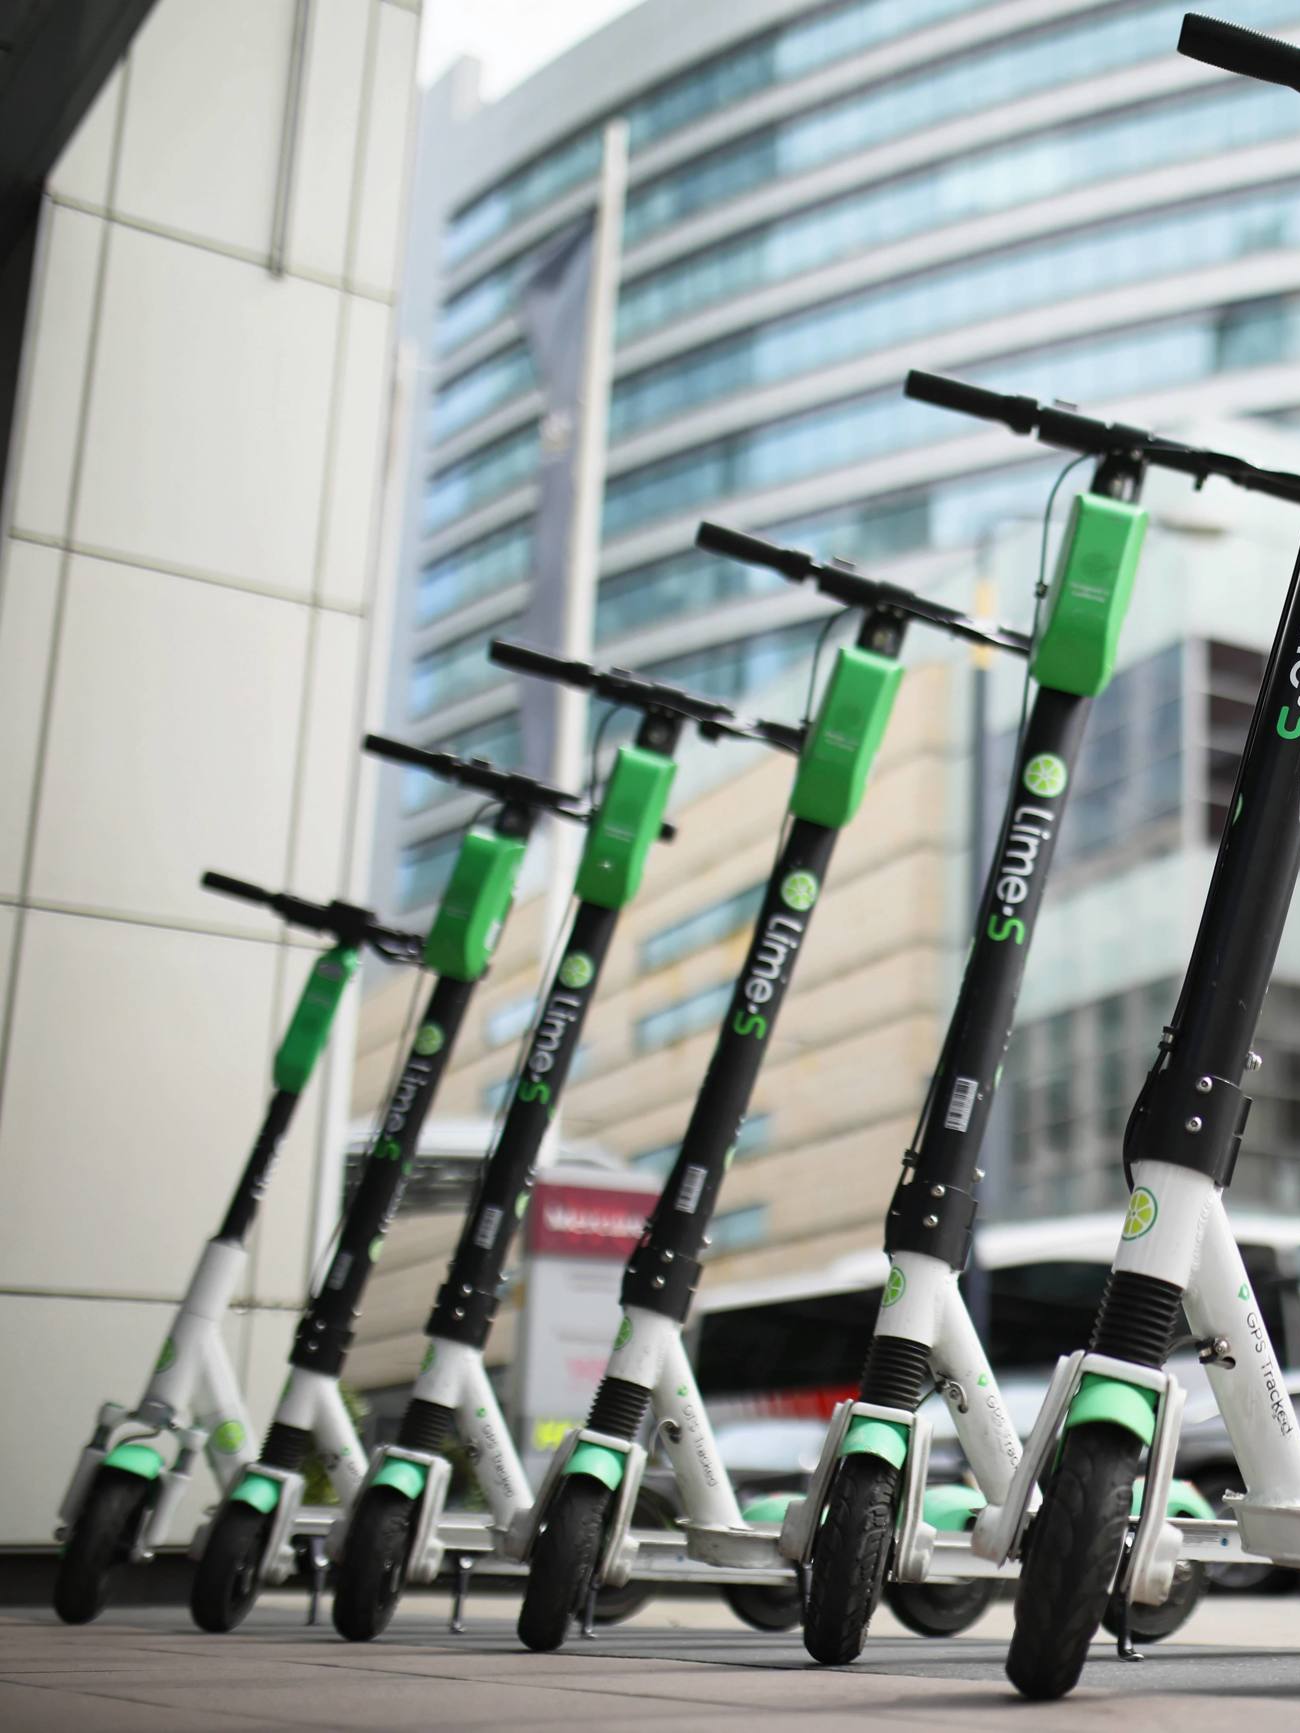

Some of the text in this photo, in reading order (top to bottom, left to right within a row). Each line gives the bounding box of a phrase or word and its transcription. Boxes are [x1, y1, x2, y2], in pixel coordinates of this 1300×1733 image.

[1246, 1311, 1294, 1437] GPS Tracked
[683, 1404, 699, 1433] GPS
